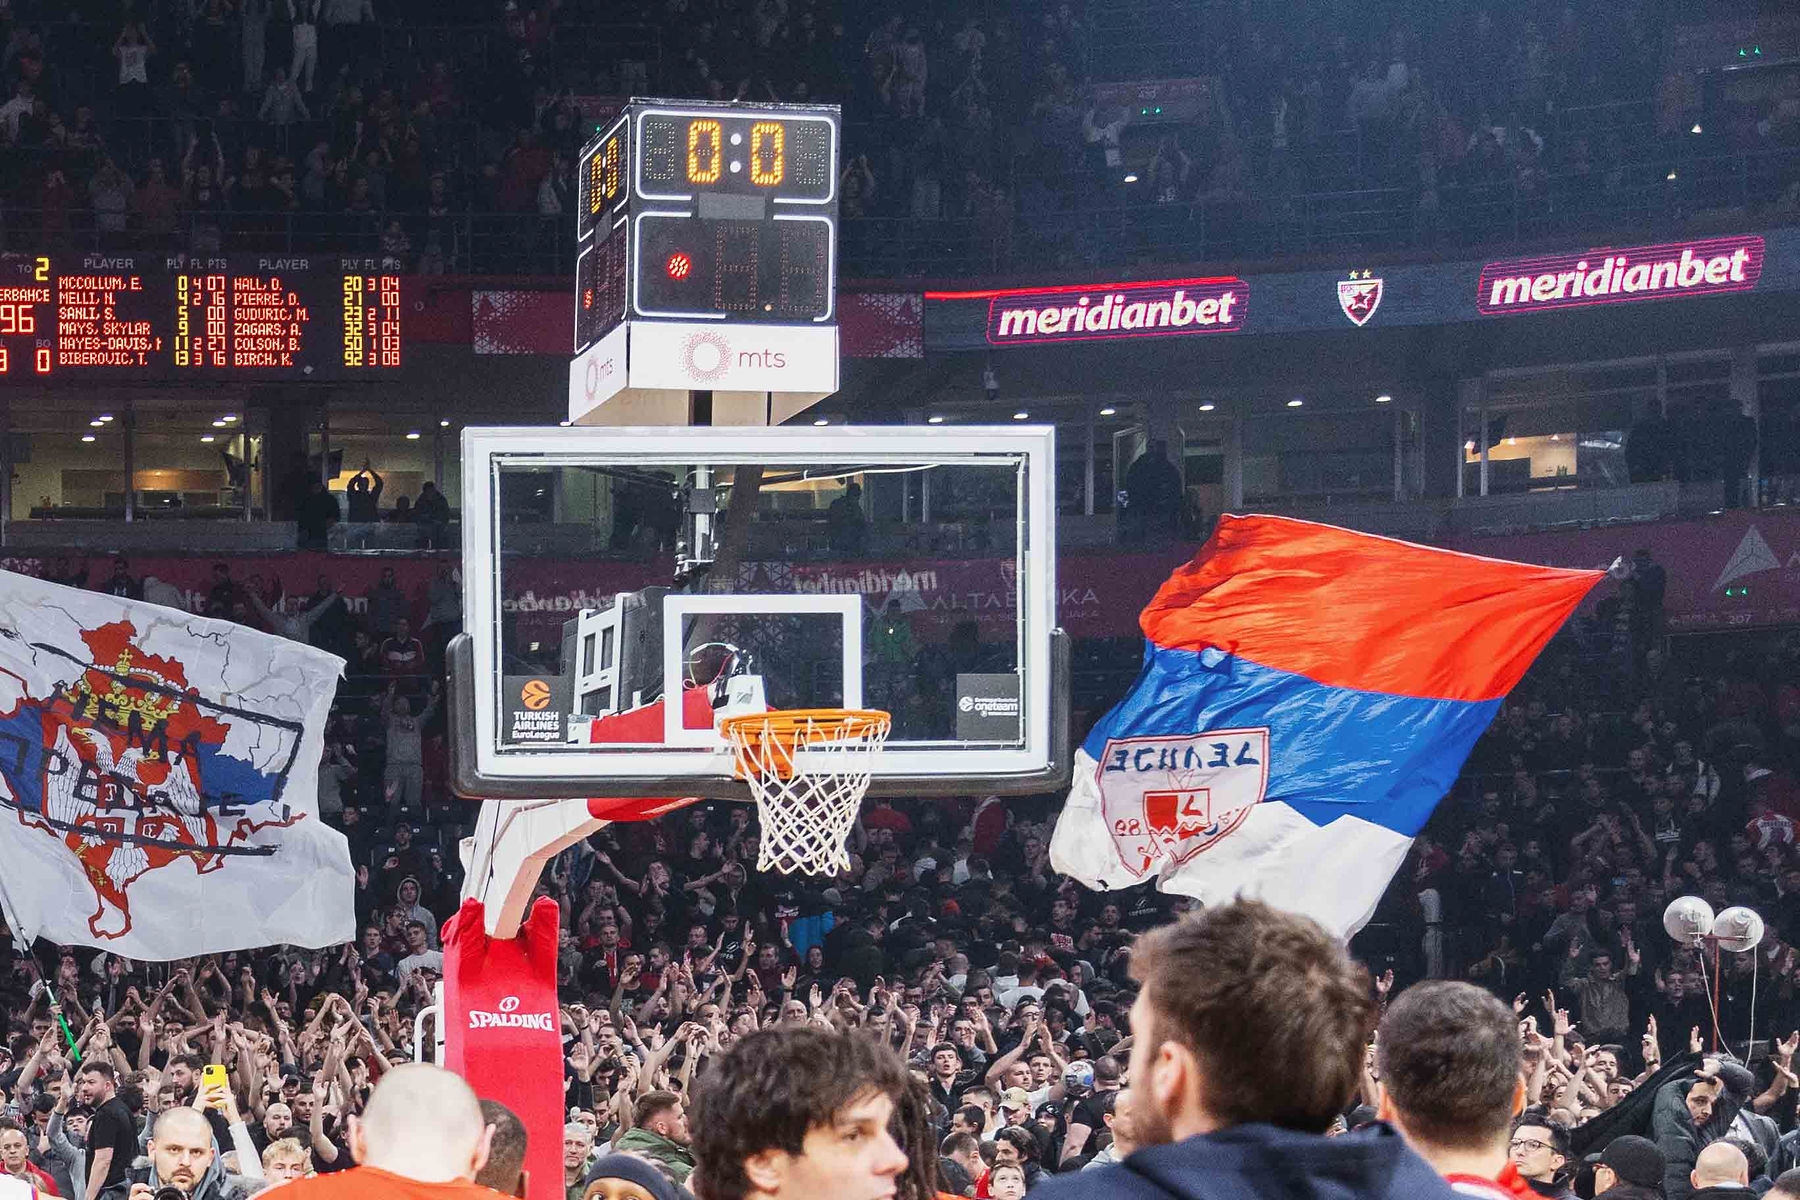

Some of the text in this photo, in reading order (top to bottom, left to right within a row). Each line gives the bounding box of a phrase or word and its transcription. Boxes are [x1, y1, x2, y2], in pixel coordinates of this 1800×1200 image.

[36, 258, 49, 280] 2
[84, 259, 134, 269] PLAYER
[259, 260, 309, 270] PLAYER
[59, 276, 224, 290] MCCOLLUM, E. 07
[1490, 249, 1749, 304] meridianbet
[235, 278, 266, 290] HALL,
[344, 277, 361, 291] 20
[382, 277, 399, 291] 04
[59, 291, 225, 305] MELLI, N. 16
[235, 293, 283, 305] PIERRE,
[344, 292, 362, 305] 21
[0, 305, 34, 333] 96
[59, 307, 100, 320] SANLI,
[104, 307, 115, 320] S.
[234, 308, 291, 320] GUDURIC,
[296, 308, 309, 320] M.
[344, 307, 362, 321] 23
[999, 291, 1235, 335] meridianbet
[59, 322, 98, 335] MAYS,
[103, 322, 150, 335] SKYLAR
[234, 322, 399, 337] ZAGARS, A. 32 04
[60, 337, 152, 350] HAYES-DAVIS,
[208, 336, 225, 350] 27
[235, 336, 399, 350] COLSON, B. 50 03
[37, 349, 50, 372] 0
[60, 351, 225, 365] BIBEROVIC, T. 13 16
[235, 351, 399, 365] BIRCH, K. 92 08
[739, 348, 786, 368] mts
[931, 588, 1100, 610] ALTABKA
[513, 711, 559, 721] TURKISH
[512, 721, 560, 731] AIRLINES
[512, 731, 560, 741] EuroLeague
[469, 1010, 556, 1032] SPALDING
